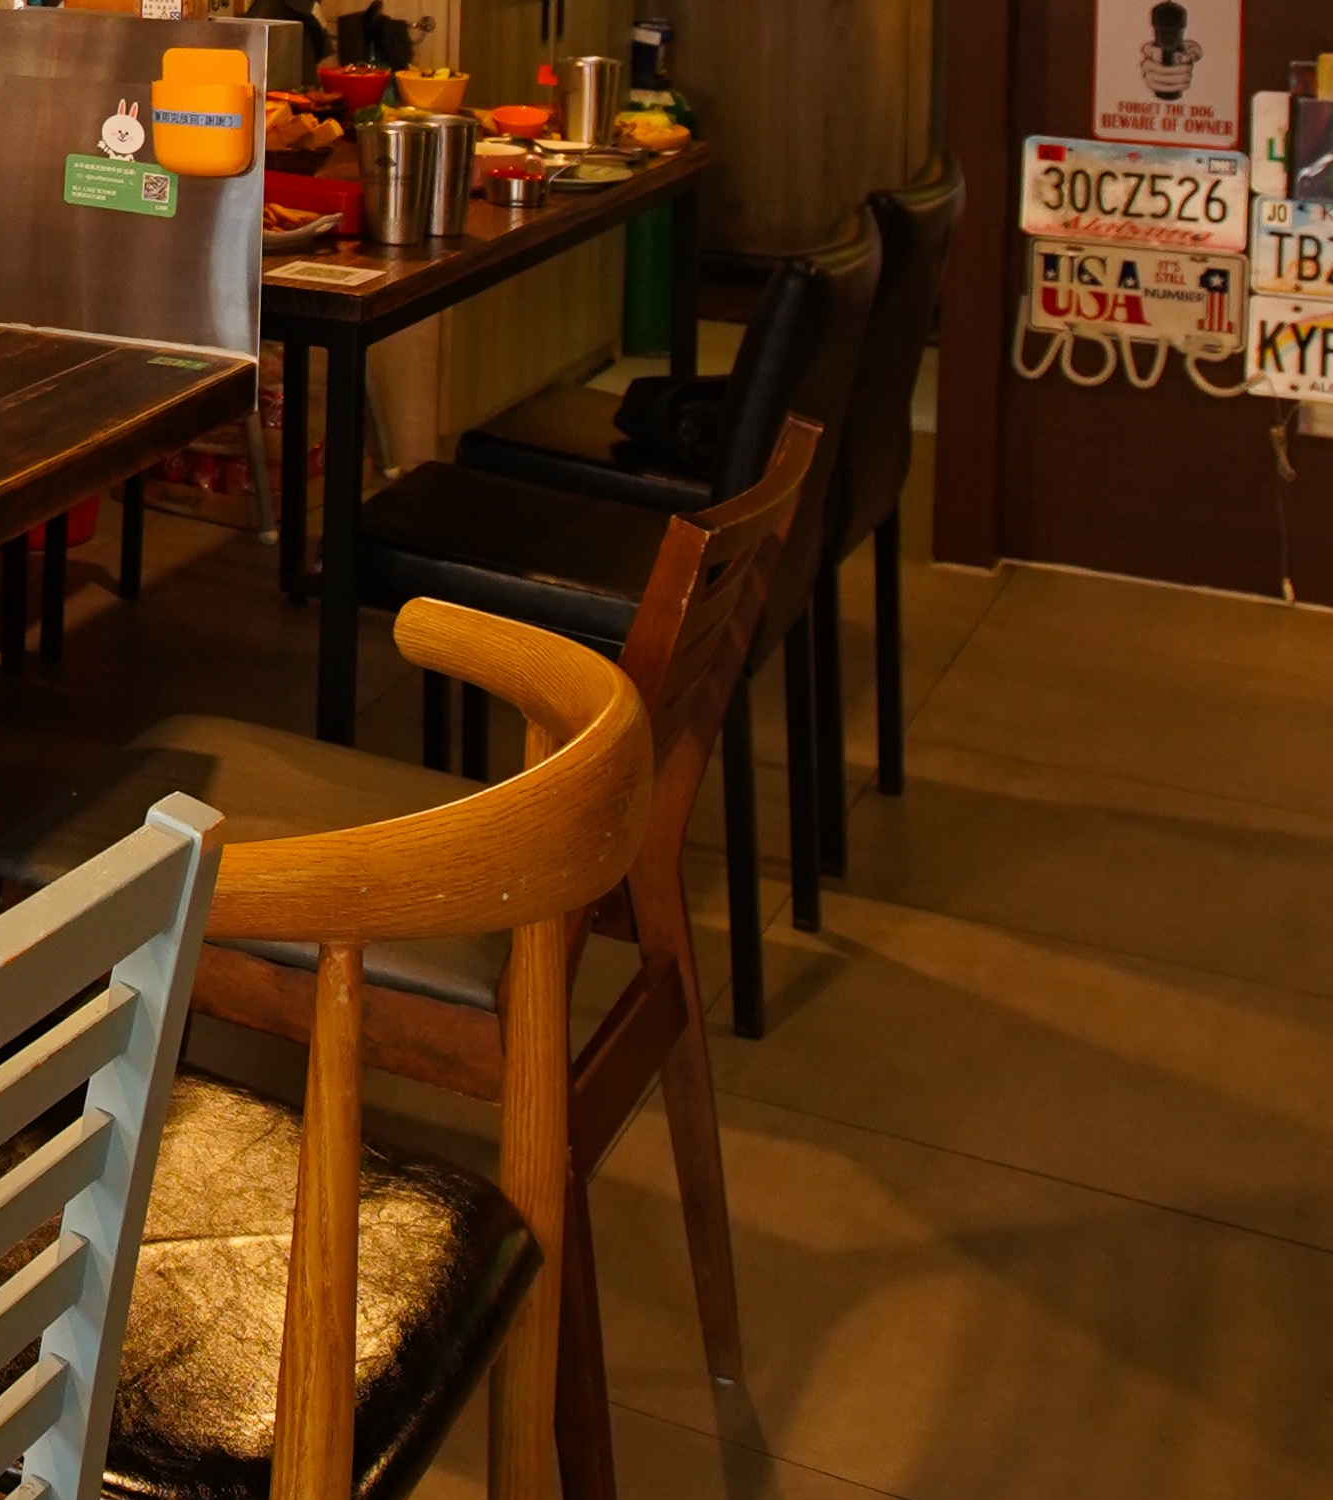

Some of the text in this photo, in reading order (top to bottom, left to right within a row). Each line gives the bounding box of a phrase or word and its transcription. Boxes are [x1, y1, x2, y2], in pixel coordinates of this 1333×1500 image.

[1118, 101, 1214, 117] FORGET THE DOG
[1102, 113, 1233, 135] BEWARE OF OWNER
[1044, 167, 1226, 222] 30CZ526
[1268, 204, 1287, 222] JO
[1155, 272, 1185, 284] STILL
[1038, 254, 1151, 326] USA
[1145, 288, 1206, 302] NUMBER
